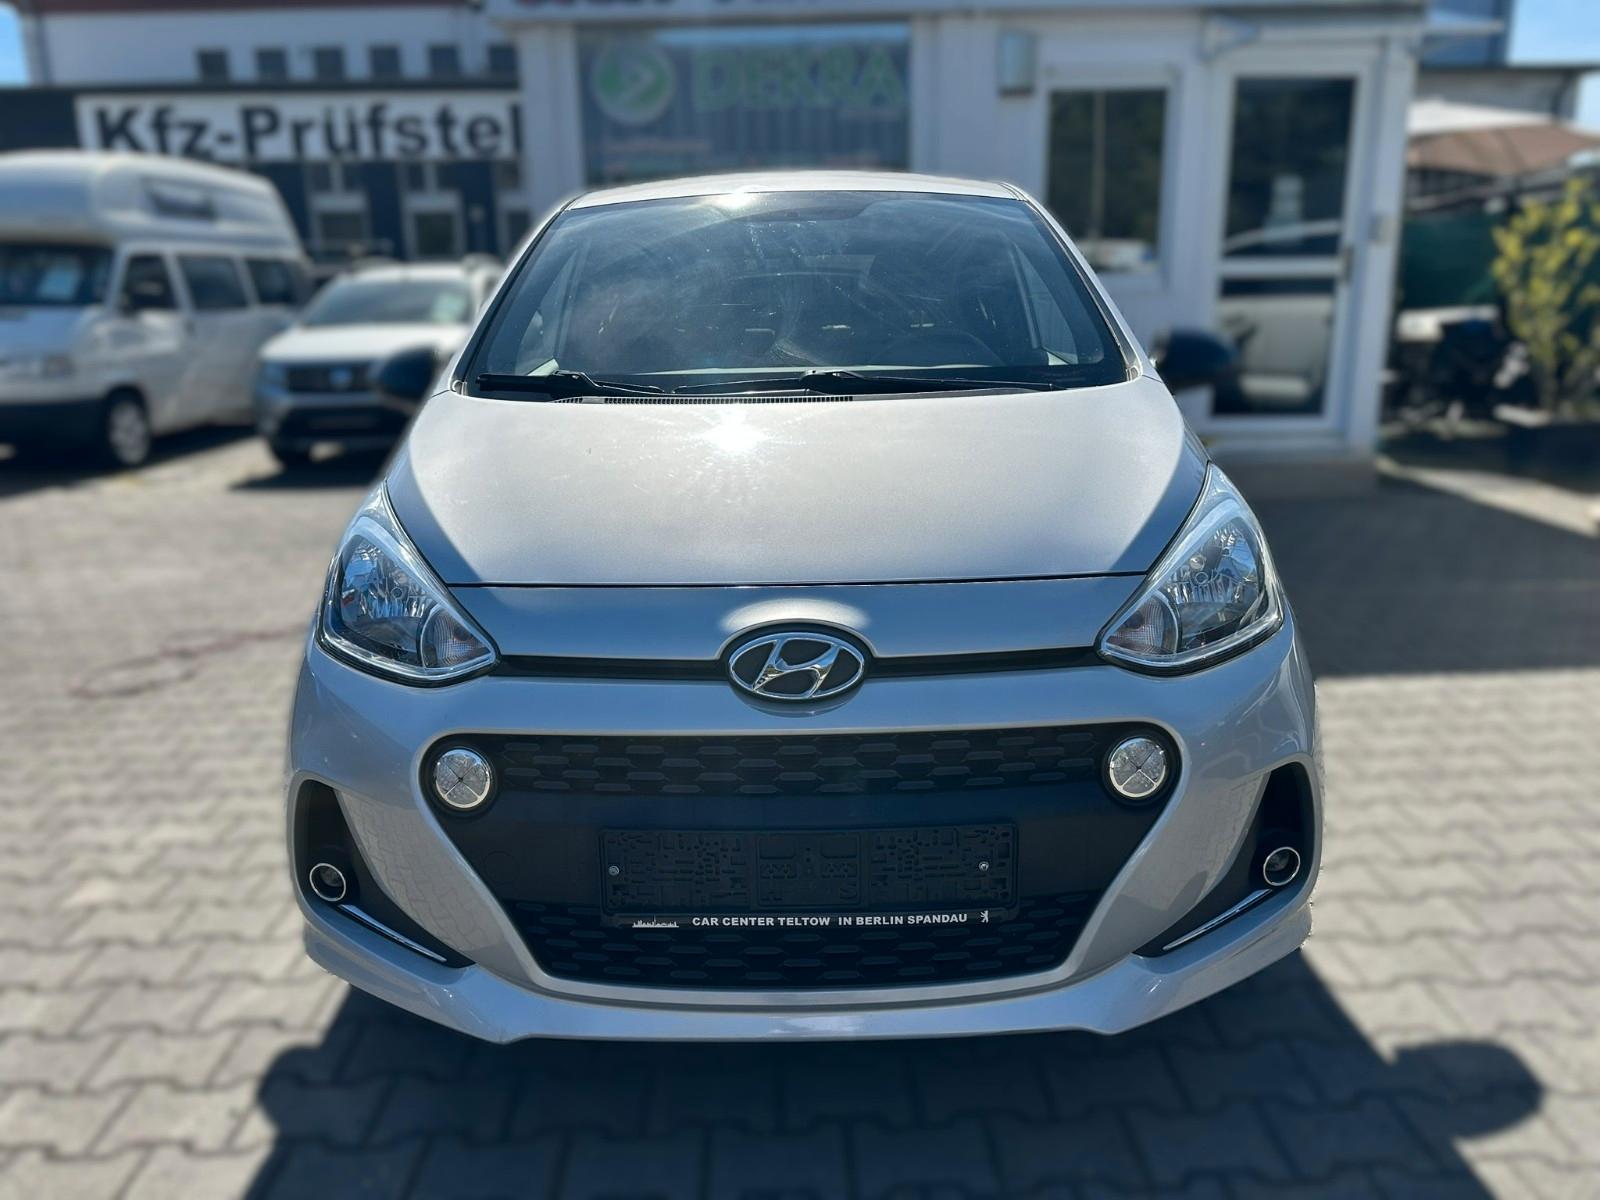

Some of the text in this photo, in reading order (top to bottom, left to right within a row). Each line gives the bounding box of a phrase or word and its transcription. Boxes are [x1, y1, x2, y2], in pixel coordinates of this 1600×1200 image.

[691, 47, 906, 112] DEKRA
[692, 913, 968, 926] CAR CENTER TELTOW IN BERLIN SPANDAU
